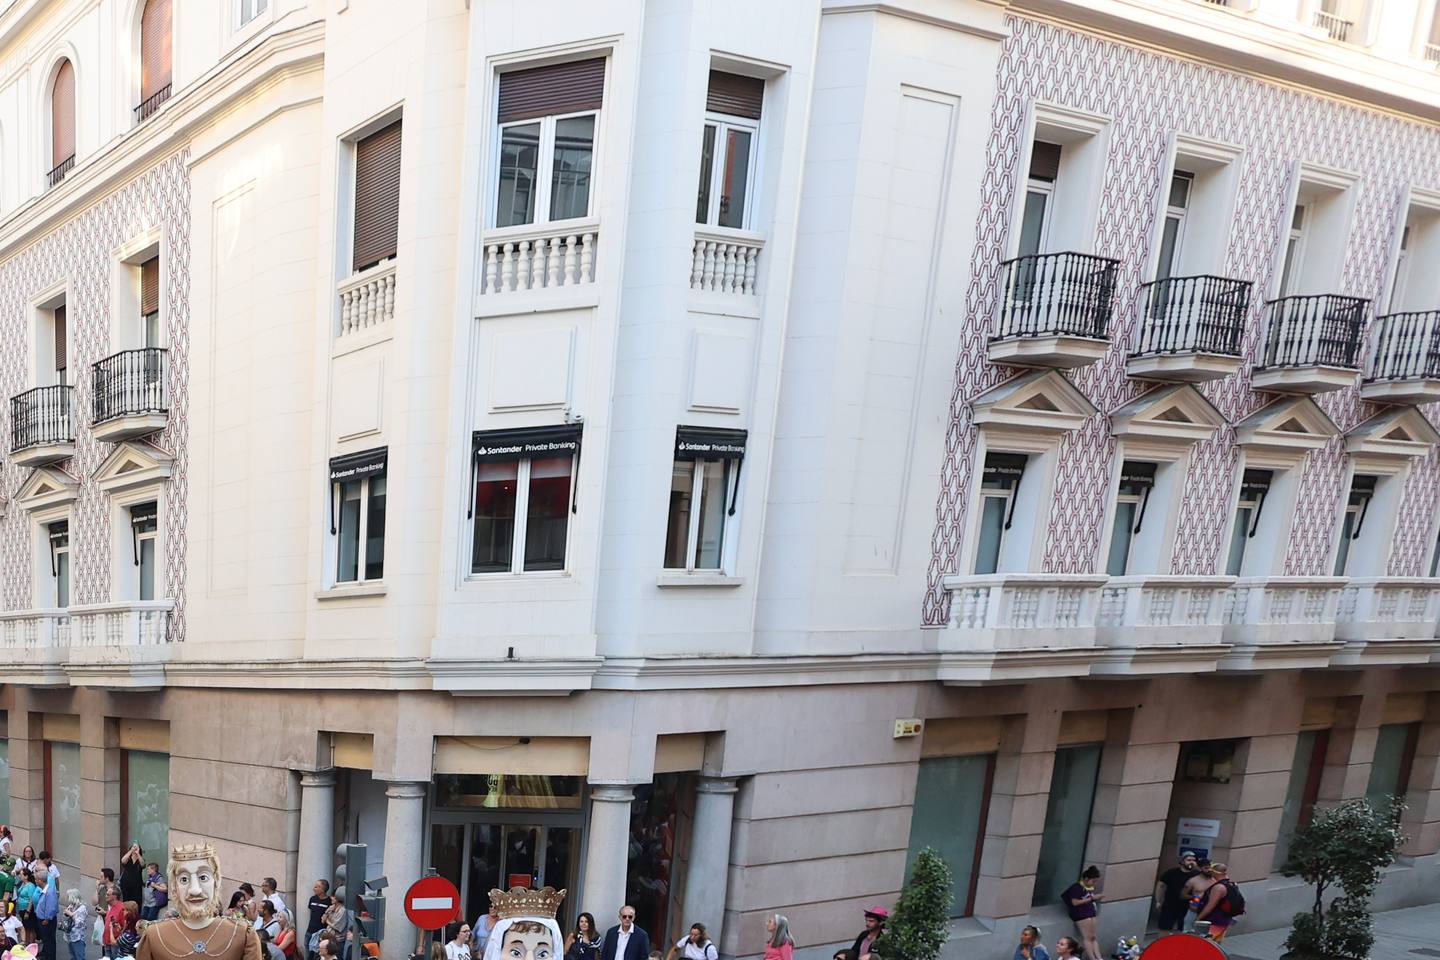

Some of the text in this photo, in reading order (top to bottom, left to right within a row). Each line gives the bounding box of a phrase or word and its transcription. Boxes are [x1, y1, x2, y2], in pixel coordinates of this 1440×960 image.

[487, 445, 522, 455] Santander
[549, 442, 576, 450] Banking
[685, 442, 711, 451] Santander
